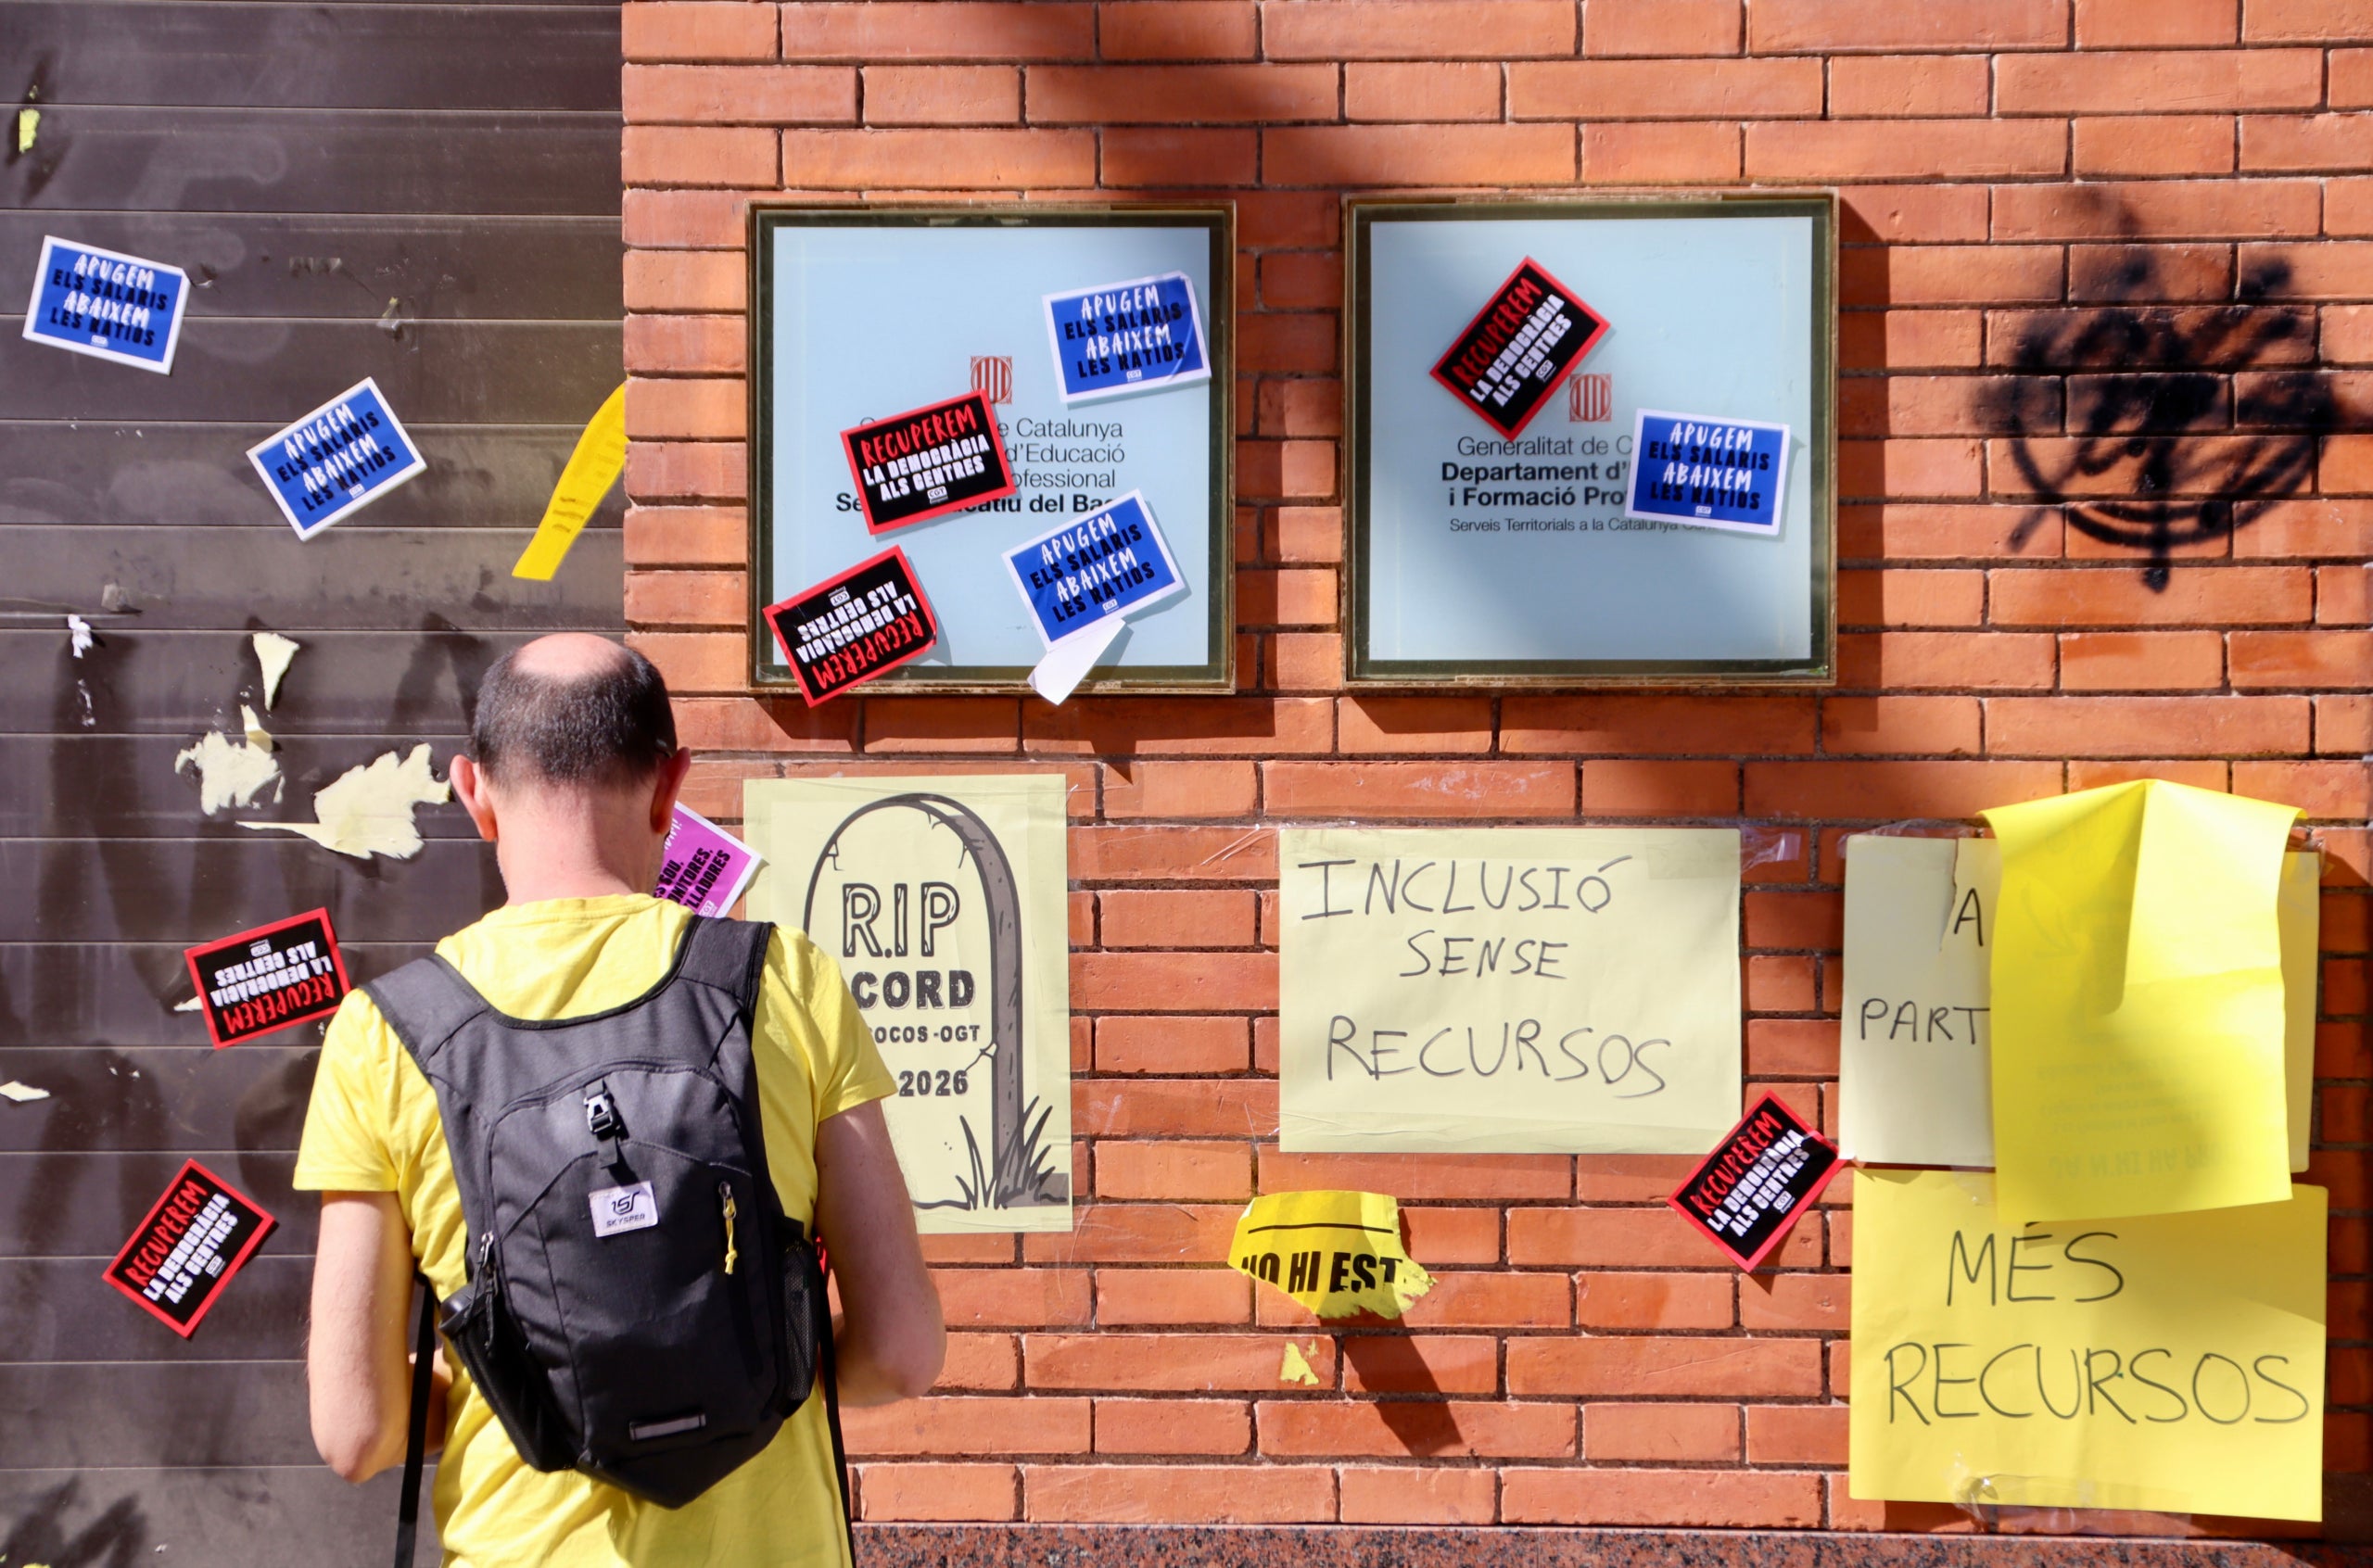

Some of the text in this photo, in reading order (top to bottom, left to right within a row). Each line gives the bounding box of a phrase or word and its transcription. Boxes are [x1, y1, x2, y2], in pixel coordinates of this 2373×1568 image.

[52, 269, 168, 310] ELS SALARIS
[74, 254, 155, 292] APUGEM
[50, 307, 82, 329] LES
[89, 318, 155, 347] RATIOS
[63, 290, 150, 330] ABAIXEM
[1064, 302, 1183, 340] ELS SALARIS
[1081, 285, 1160, 320] APUGEM
[1085, 323, 1172, 360] ABAIXEM
[1452, 277, 1542, 387] RECUPEREM
[1470, 294, 1565, 403] LA DEMOCRÀCIA
[1077, 342, 1186, 378] LES RATIOS
[1492, 313, 1572, 408] ALS CENTRES
[1537, 360, 1553, 378] CGT
[276, 411, 380, 483] ELS SALARIS
[284, 402, 356, 461] APUGEM
[860, 404, 977, 469] RECUPEREM
[997, 418, 1123, 441] e Catalunya
[1006, 443, 1125, 464] d'Educació
[1457, 436, 1574, 456] Generalitat
[1581, 436, 1609, 456] de
[1669, 422, 1753, 452] APUGEM
[301, 446, 397, 512] LES RATIOS
[302, 433, 380, 493] ABAIXEM
[862, 434, 991, 487] LA DEMOCRÀCIA
[880, 455, 985, 501] ALS CENTRES
[1011, 468, 1115, 488] ofessional
[1440, 461, 1630, 486] Departament d'
[1648, 441, 1770, 471] ELS SALARIS
[1663, 462, 1752, 492] ABAIXEM
[835, 493, 862, 512] Se
[1036, 494, 1063, 512] del
[1072, 494, 1111, 512] Ba
[928, 487, 945, 499] CGT
[1449, 487, 1627, 506] i Formació Pro
[1650, 482, 1760, 510] LES RATIOS
[1040, 512, 1118, 565] APUGEM
[1450, 518, 1501, 532] Serveis
[1504, 518, 1576, 532] Territorials
[1580, 522, 1589, 532] a
[1592, 518, 1605, 532] la
[1608, 518, 1679, 535] Catalunya
[1030, 524, 1143, 589] ELS SALARIS
[1056, 547, 1138, 602] ABAIXEM
[796, 580, 898, 642] ALS CENTRES
[831, 591, 850, 605] CGT
[1052, 562, 1155, 623] LES RATIOS
[795, 593, 917, 664] LA DEMOCRÀCIA
[811, 610, 924, 689] RECUPEREM
[667, 847, 714, 904] ONITORES,
[684, 850, 730, 909] LLADORES
[1298, 854, 1632, 920] INCLUSIÓ
[1953, 887, 1984, 947] A
[214, 941, 317, 988] ALS CENTRES
[1400, 929, 1569, 980] SENSE
[209, 955, 334, 1007] LA DEMOCRÀCIA
[222, 971, 336, 1034] RECUPEREM
[851, 969, 975, 1011] CORD
[869, 1024, 981, 1043] OCOS-OGT
[1860, 997, 1991, 1045] PART
[1326, 1015, 1671, 1098] RECURSOS
[898, 1069, 969, 1097] 2026
[1689, 1111, 1783, 1217] RECUPEREM
[1707, 1129, 1804, 1233] LA DEMOCRÀCIA
[1729, 1147, 1810, 1237] ALS CENTRES
[1775, 1192, 1791, 1208] CGT
[124, 1180, 208, 1286] RECUPEREM
[142, 1193, 231, 1301] LA DEMOCRÀCIA
[164, 1210, 238, 1304] ALS CENTRES
[1288, 1251, 1321, 1294] HI
[1329, 1252, 1403, 1294] EST
[1884, 1341, 2309, 1426] RECURSOS
